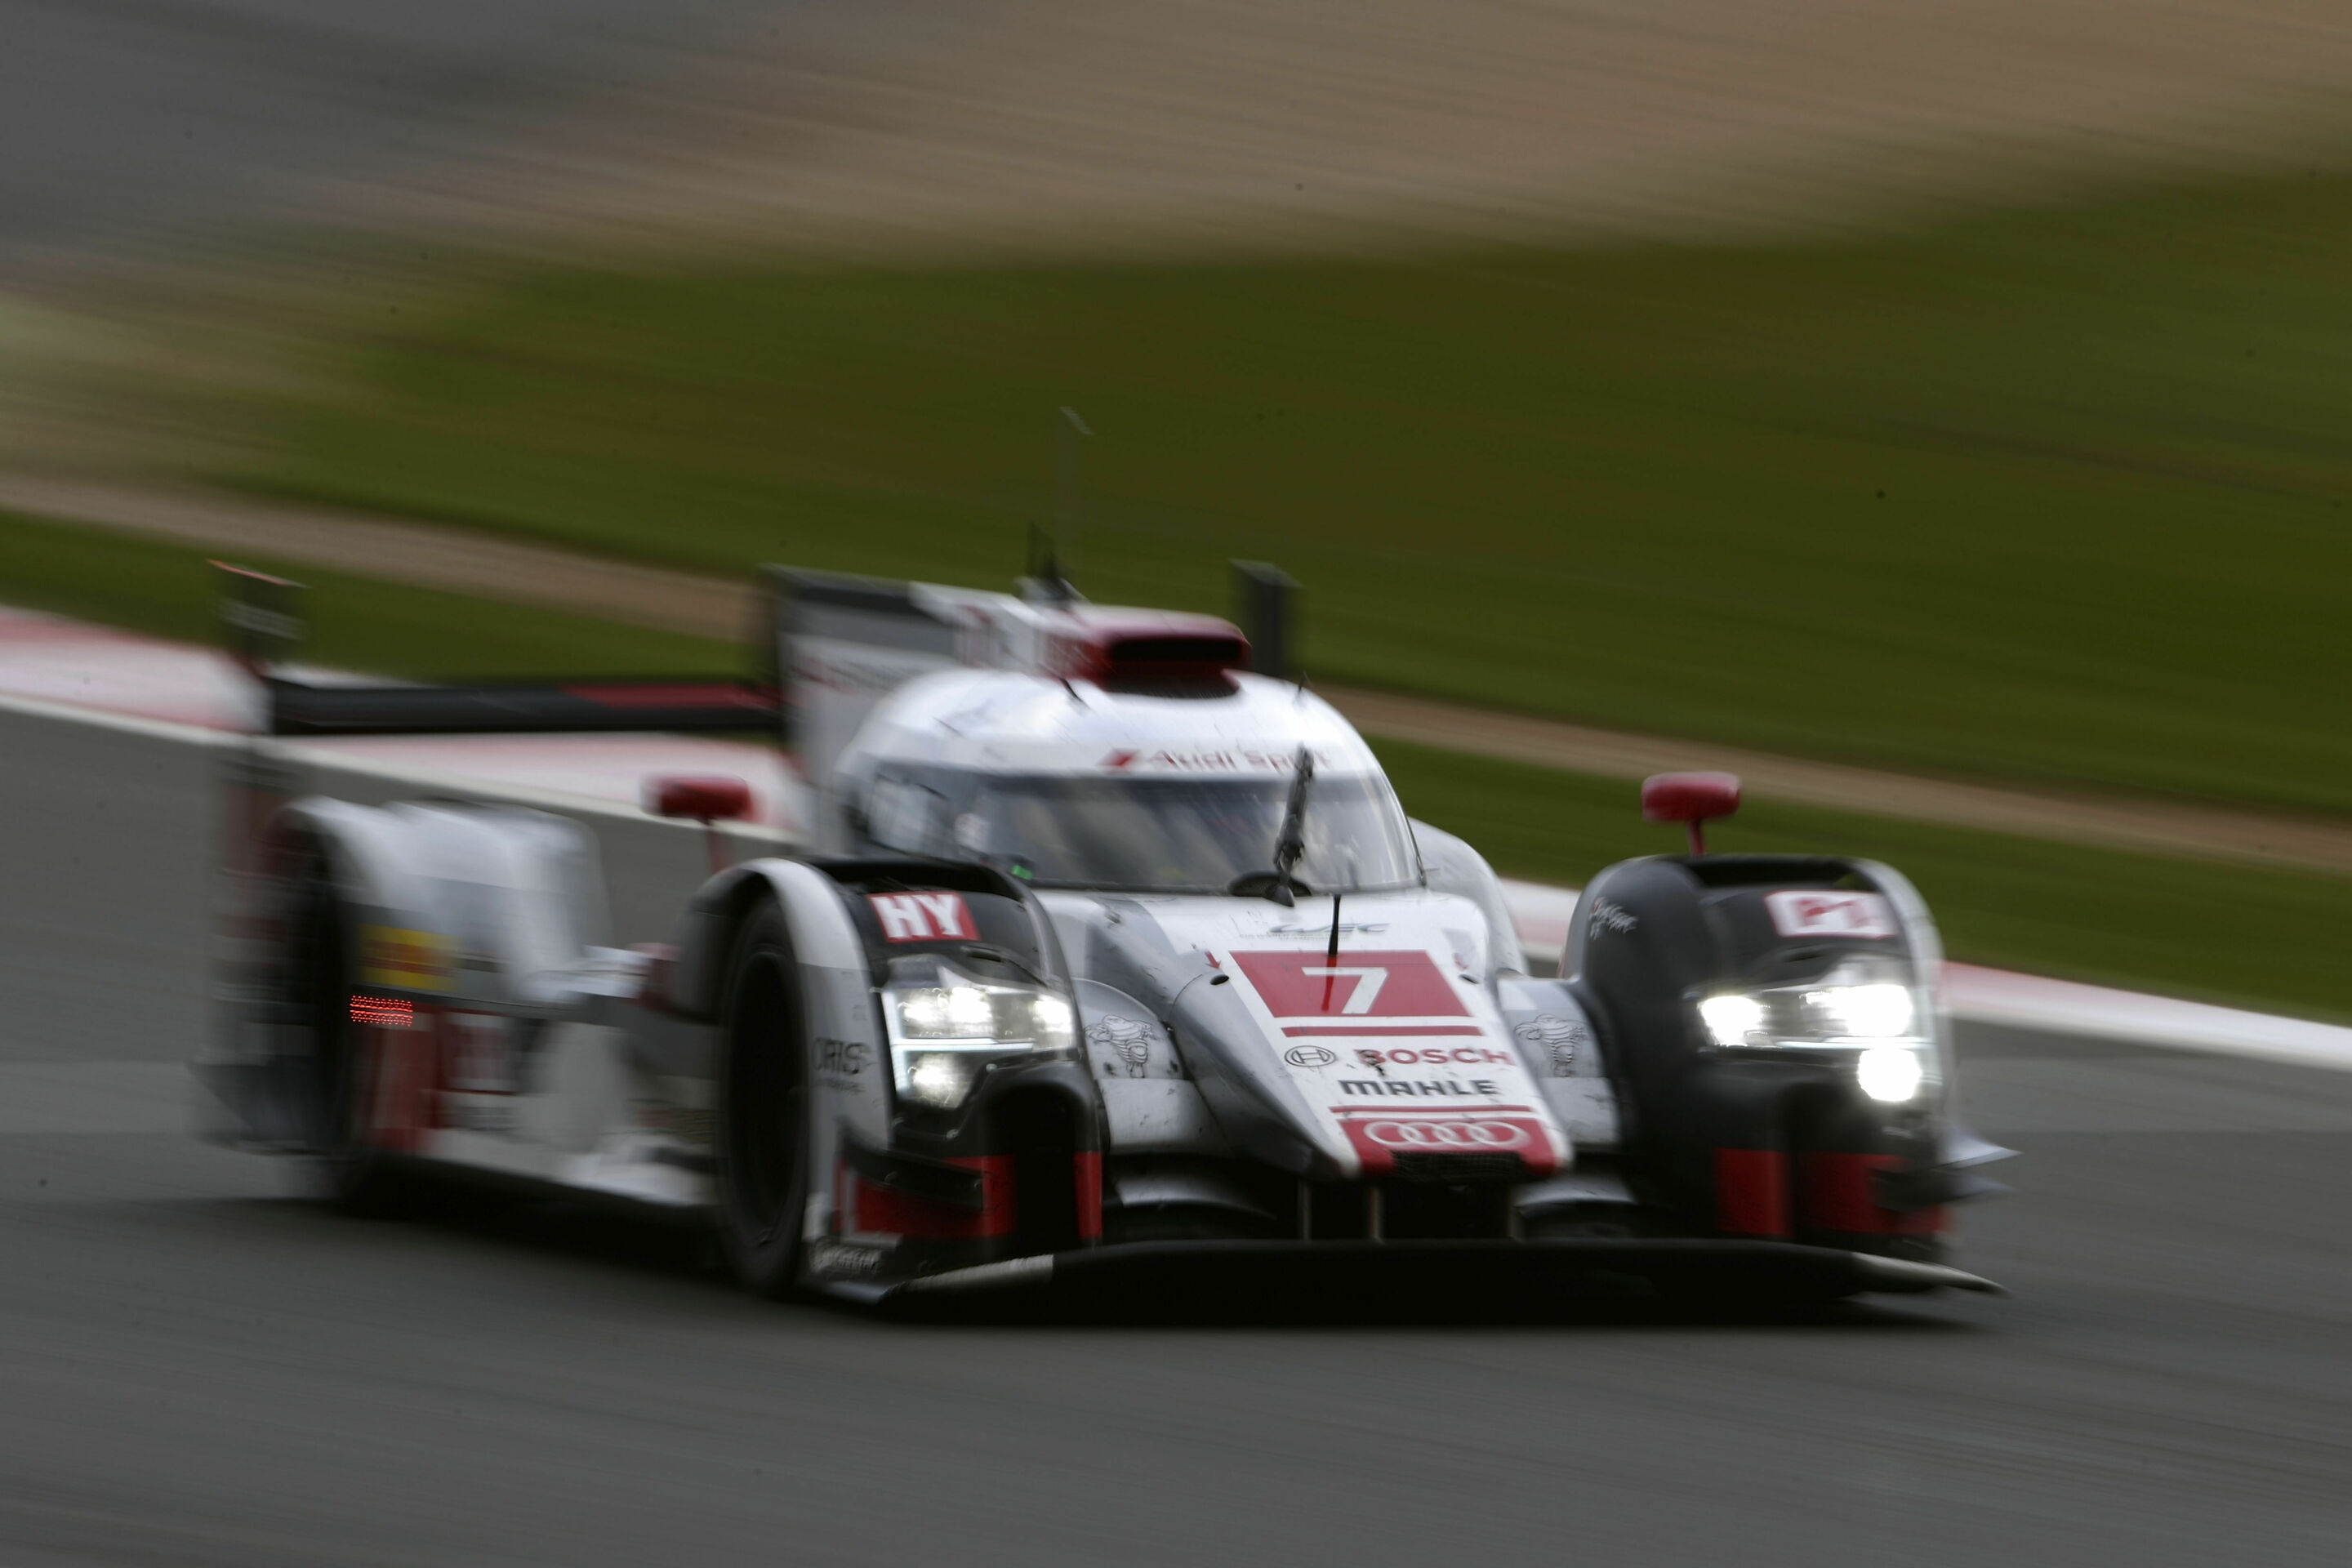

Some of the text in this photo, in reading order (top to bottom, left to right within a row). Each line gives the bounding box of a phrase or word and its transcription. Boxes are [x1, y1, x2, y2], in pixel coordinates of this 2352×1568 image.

[1145, 750, 1236, 772] Audi
[870, 893, 964, 938] HY
[1301, 966, 1389, 1014] 7
[1353, 1047, 1517, 1067] BOSCH
[1338, 1079, 1500, 1096] MAHLE
